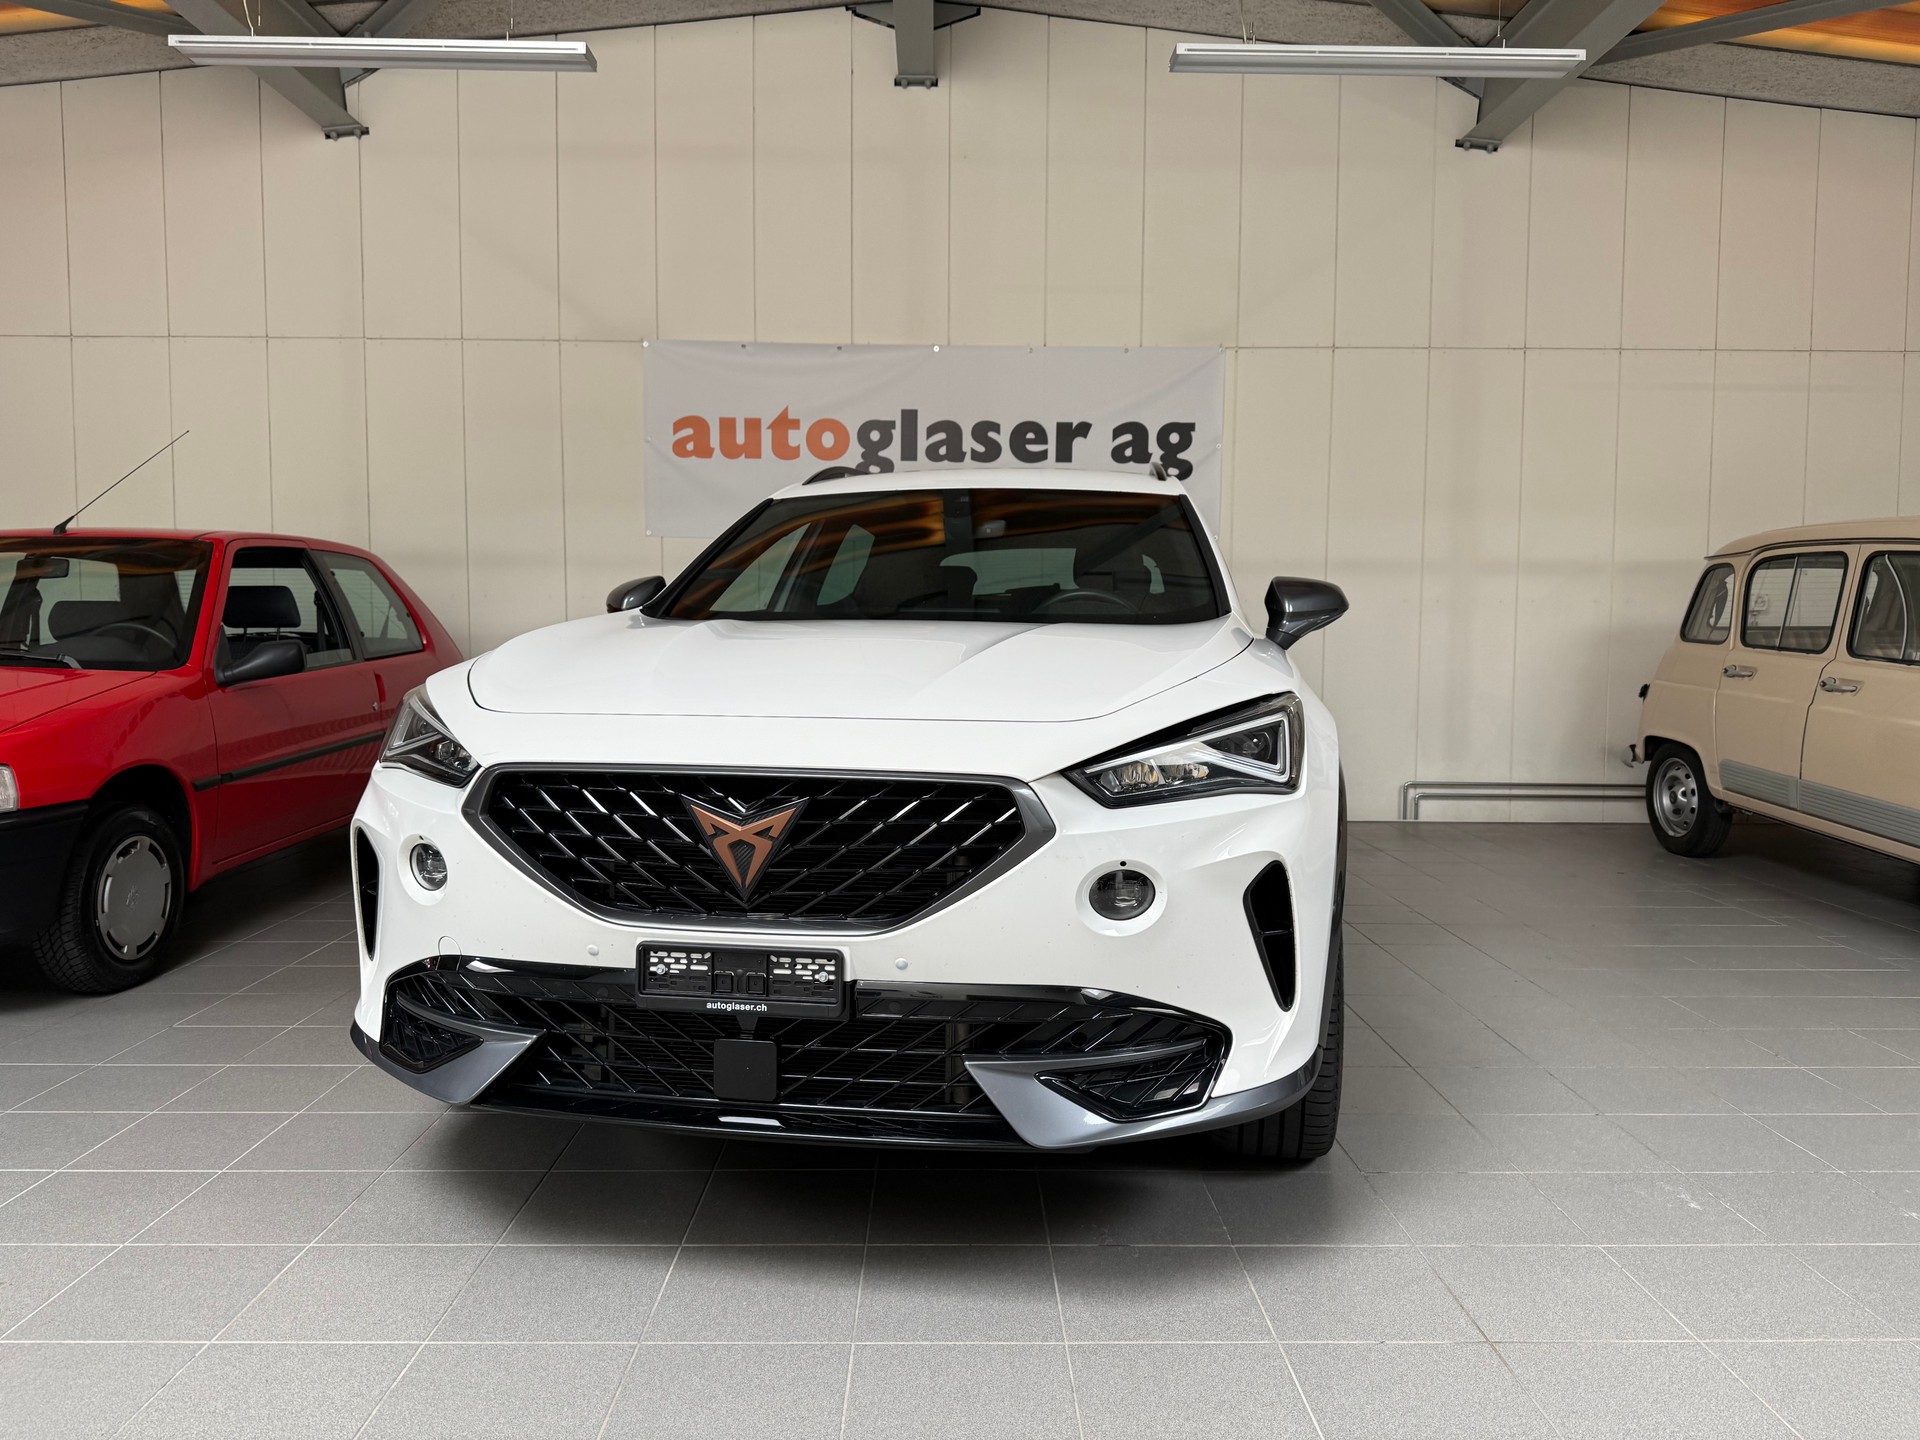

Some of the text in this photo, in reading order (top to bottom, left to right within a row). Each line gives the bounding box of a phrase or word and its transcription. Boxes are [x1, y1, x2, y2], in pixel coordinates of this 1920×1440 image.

[672, 405, 1196, 481] autoglaser ag
[706, 1001, 768, 1012] autoglaser.ch
